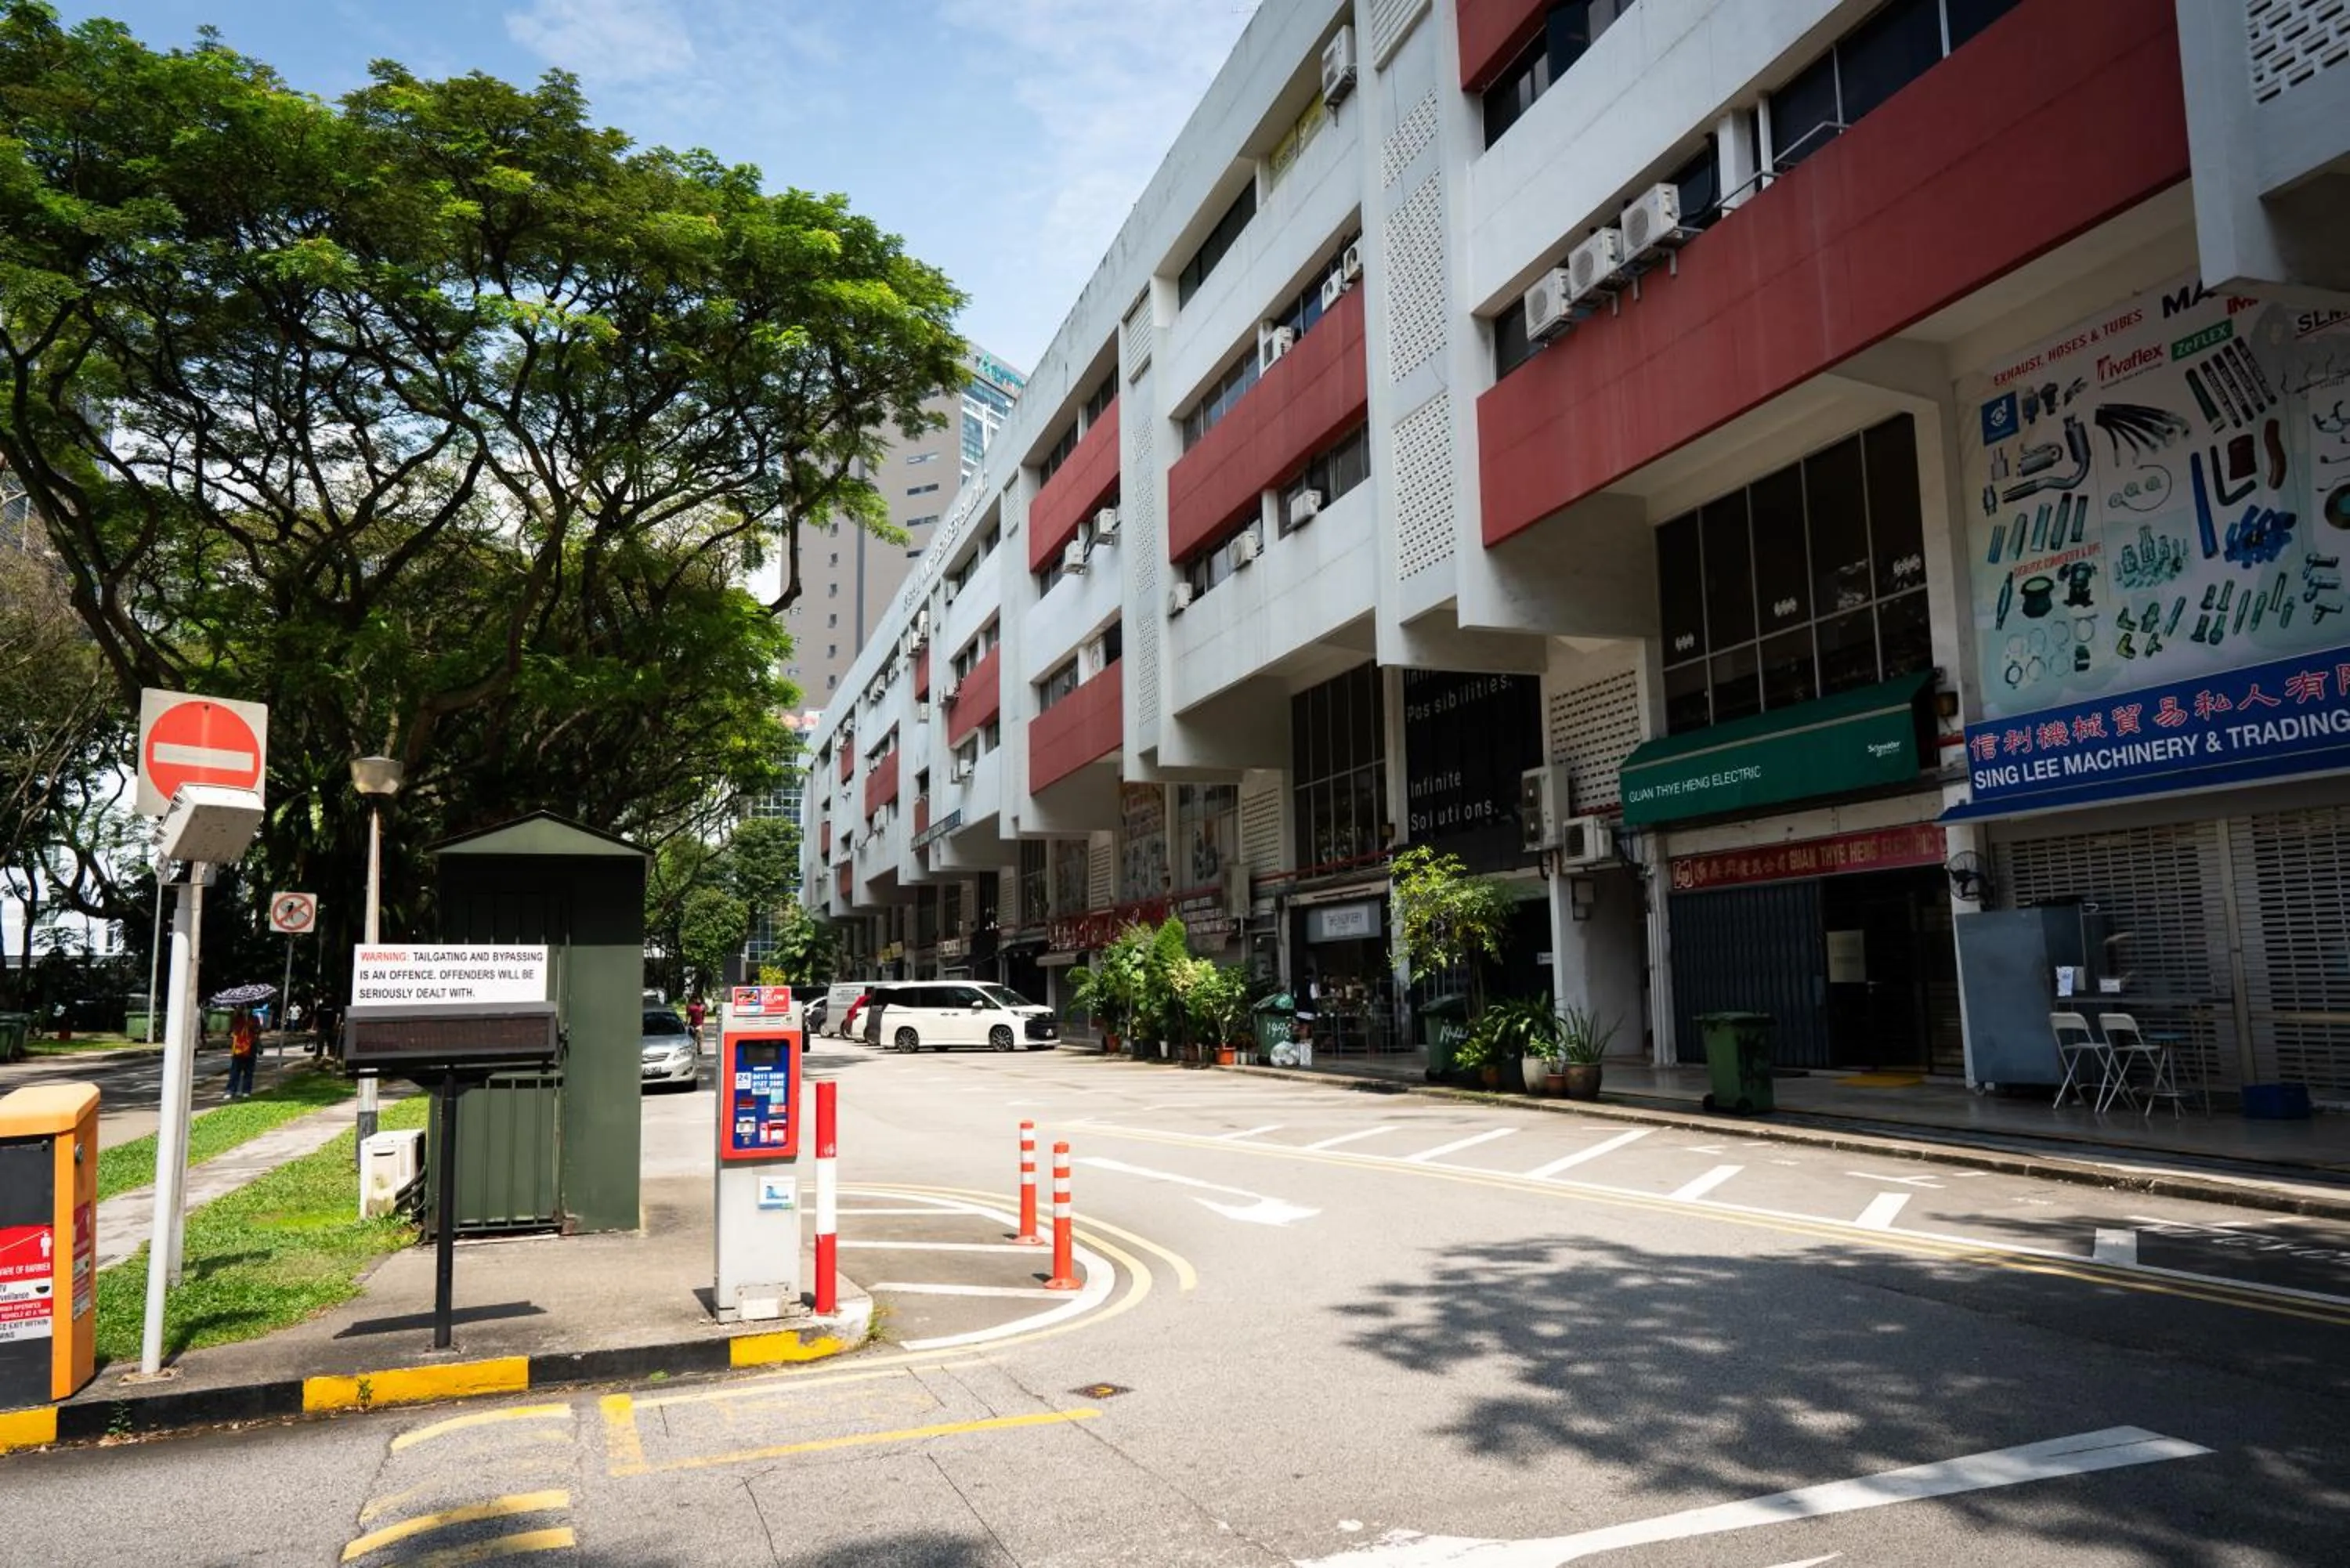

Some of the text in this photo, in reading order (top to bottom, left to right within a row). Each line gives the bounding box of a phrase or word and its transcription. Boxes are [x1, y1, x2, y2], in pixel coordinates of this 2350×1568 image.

[1994, 309, 2142, 386] EXHAUST, HOSES & TUBES
[1408, 674, 1513, 724] Possibilities.
[1974, 708, 2350, 790] SING LEE MACHINERY & TRADING
[1410, 768, 1462, 799] Infinite
[1629, 765, 1761, 803] GUAN THYE HENG ELECTRIC
[1411, 799, 1499, 832] Solutions.
[1819, 844, 1846, 866] THYE
[360, 952, 543, 962] WARNING: TAILGATING AND BYPASSING
[360, 970, 534, 980] IS AN OFFENCE. OFFENDERS WILL BE
[360, 988, 475, 999] SERIOUSLY DEALT WITH.
[16, 1266, 24, 1274] OF
